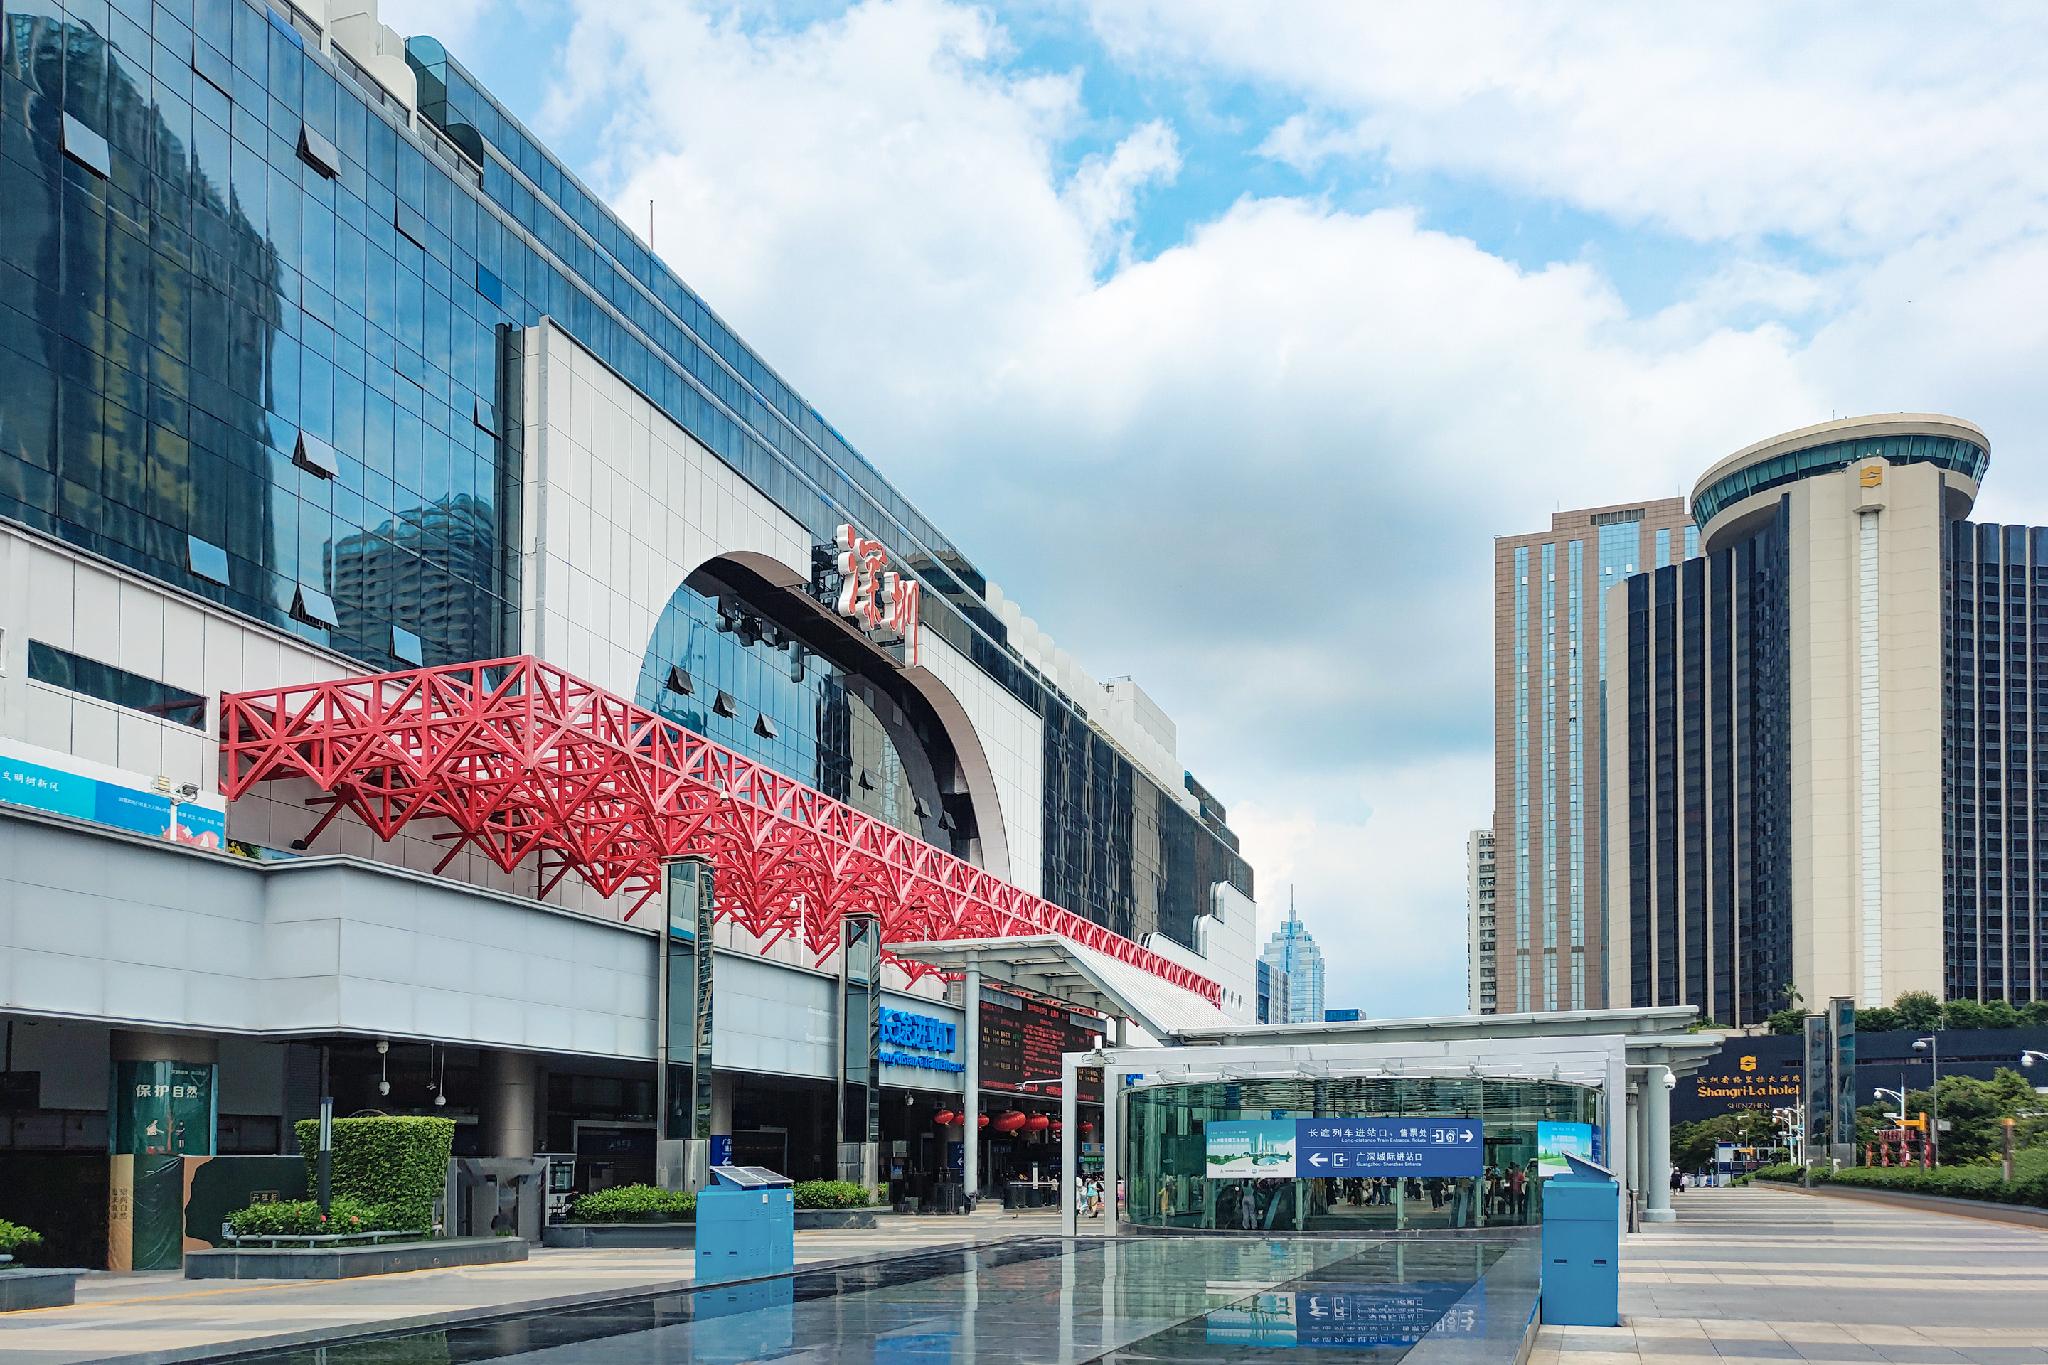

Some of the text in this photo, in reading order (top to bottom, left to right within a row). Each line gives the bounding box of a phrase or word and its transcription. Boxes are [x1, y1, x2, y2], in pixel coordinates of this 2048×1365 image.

[837, 523, 919, 668] 深圳
[136, 1084, 198, 1098] 保护自然
[1697, 1084, 1767, 1099] Shangri-La
